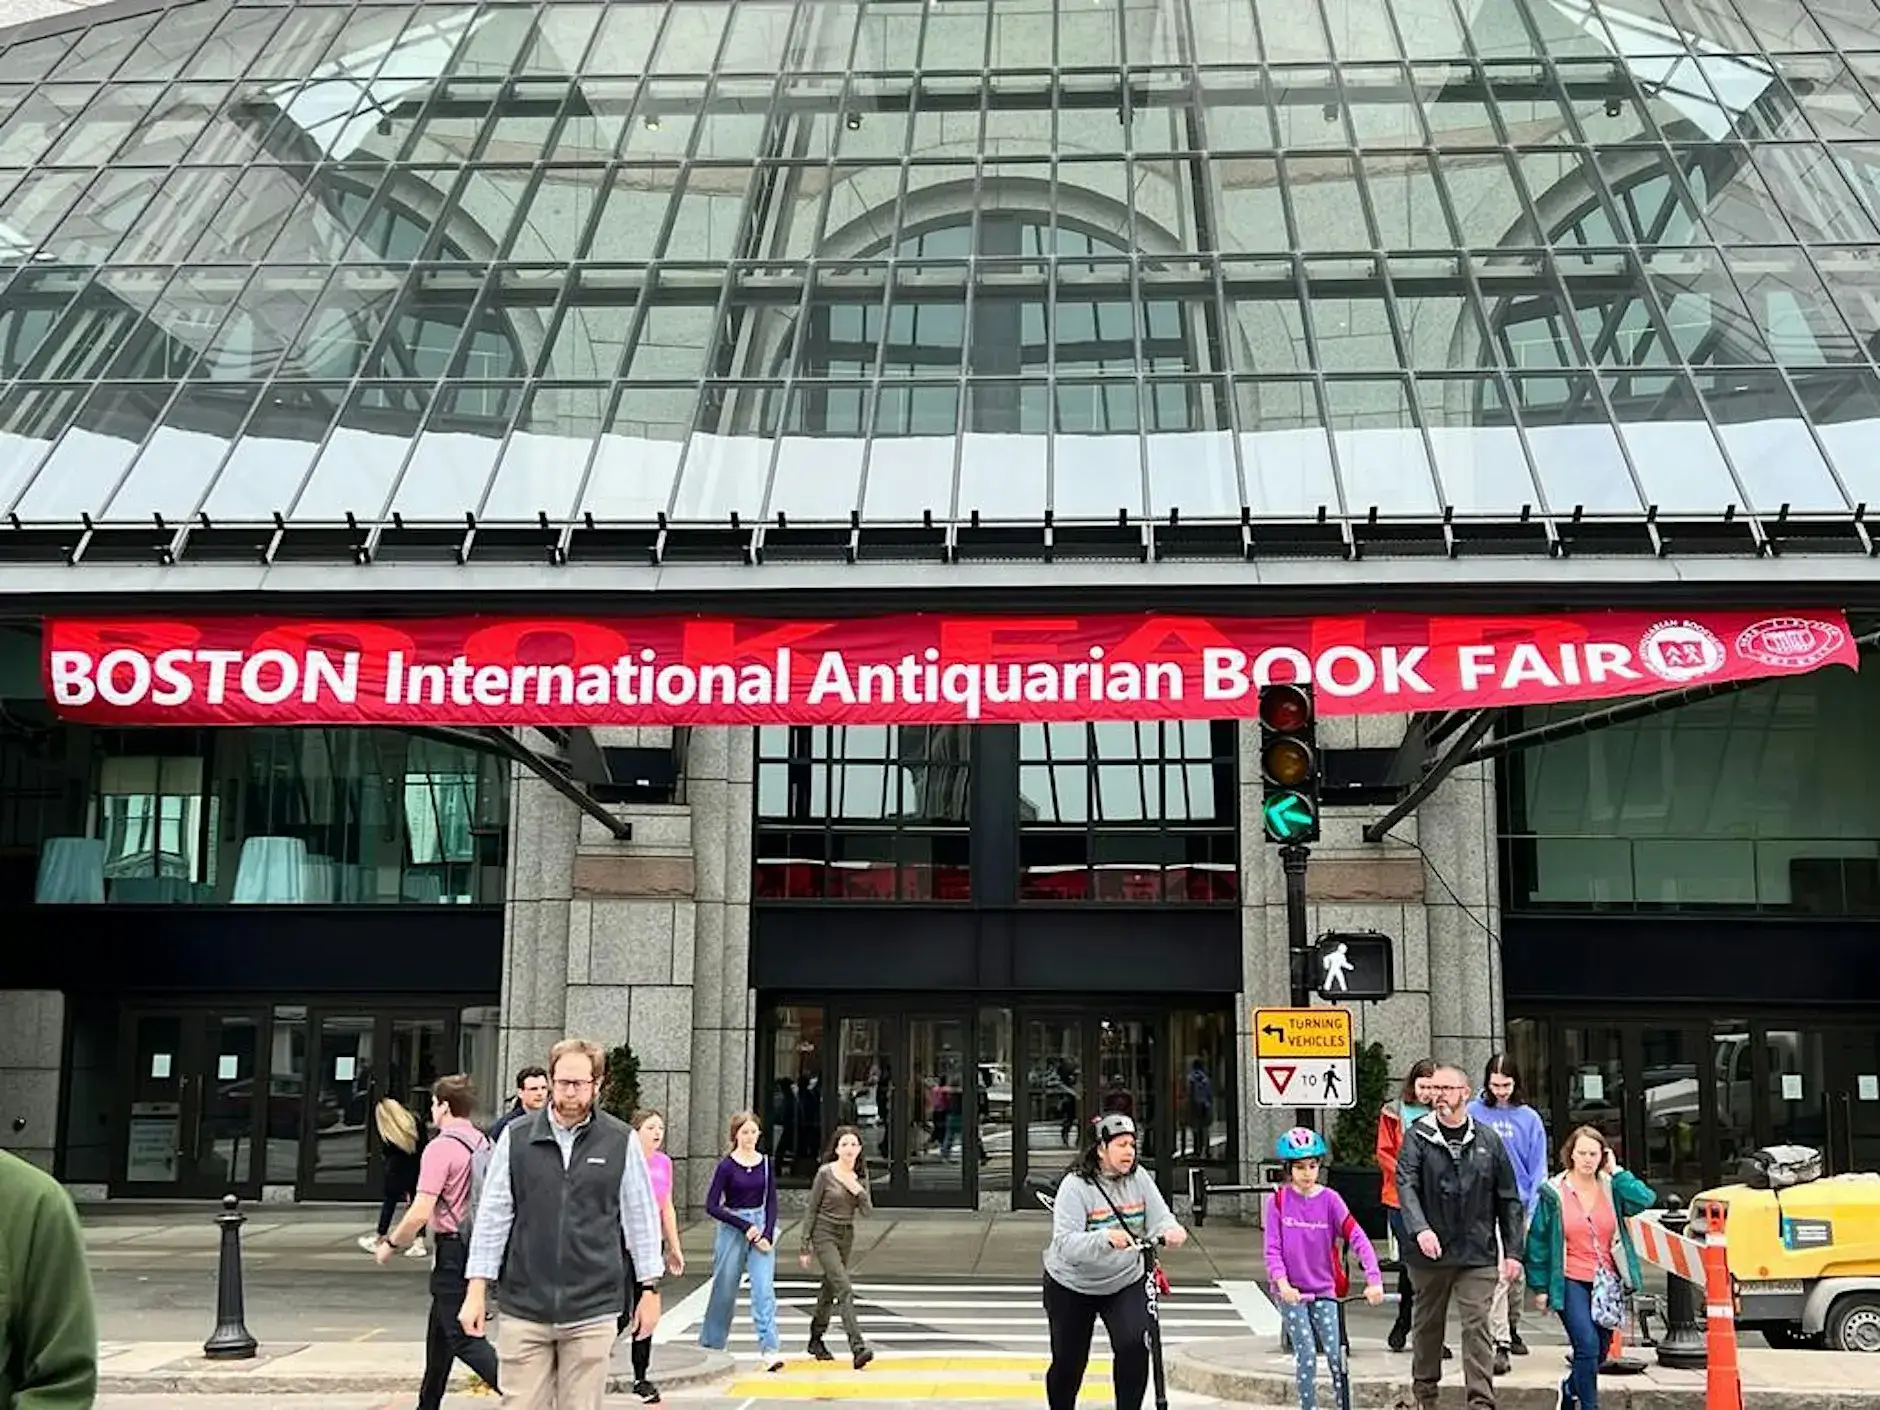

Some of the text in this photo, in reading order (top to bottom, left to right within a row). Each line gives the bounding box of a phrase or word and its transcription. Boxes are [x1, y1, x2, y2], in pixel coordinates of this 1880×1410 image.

[50, 649, 361, 706] BOSTON
[385, 647, 790, 706] International
[806, 646, 1184, 719] Antiquarian
[1203, 646, 1436, 699] BOOK
[1458, 643, 1643, 691] FAIR
[1288, 1018, 1343, 1030] TURNING
[1287, 1035, 1345, 1047] VEHICLES
[1301, 1074, 1318, 1087] TO
